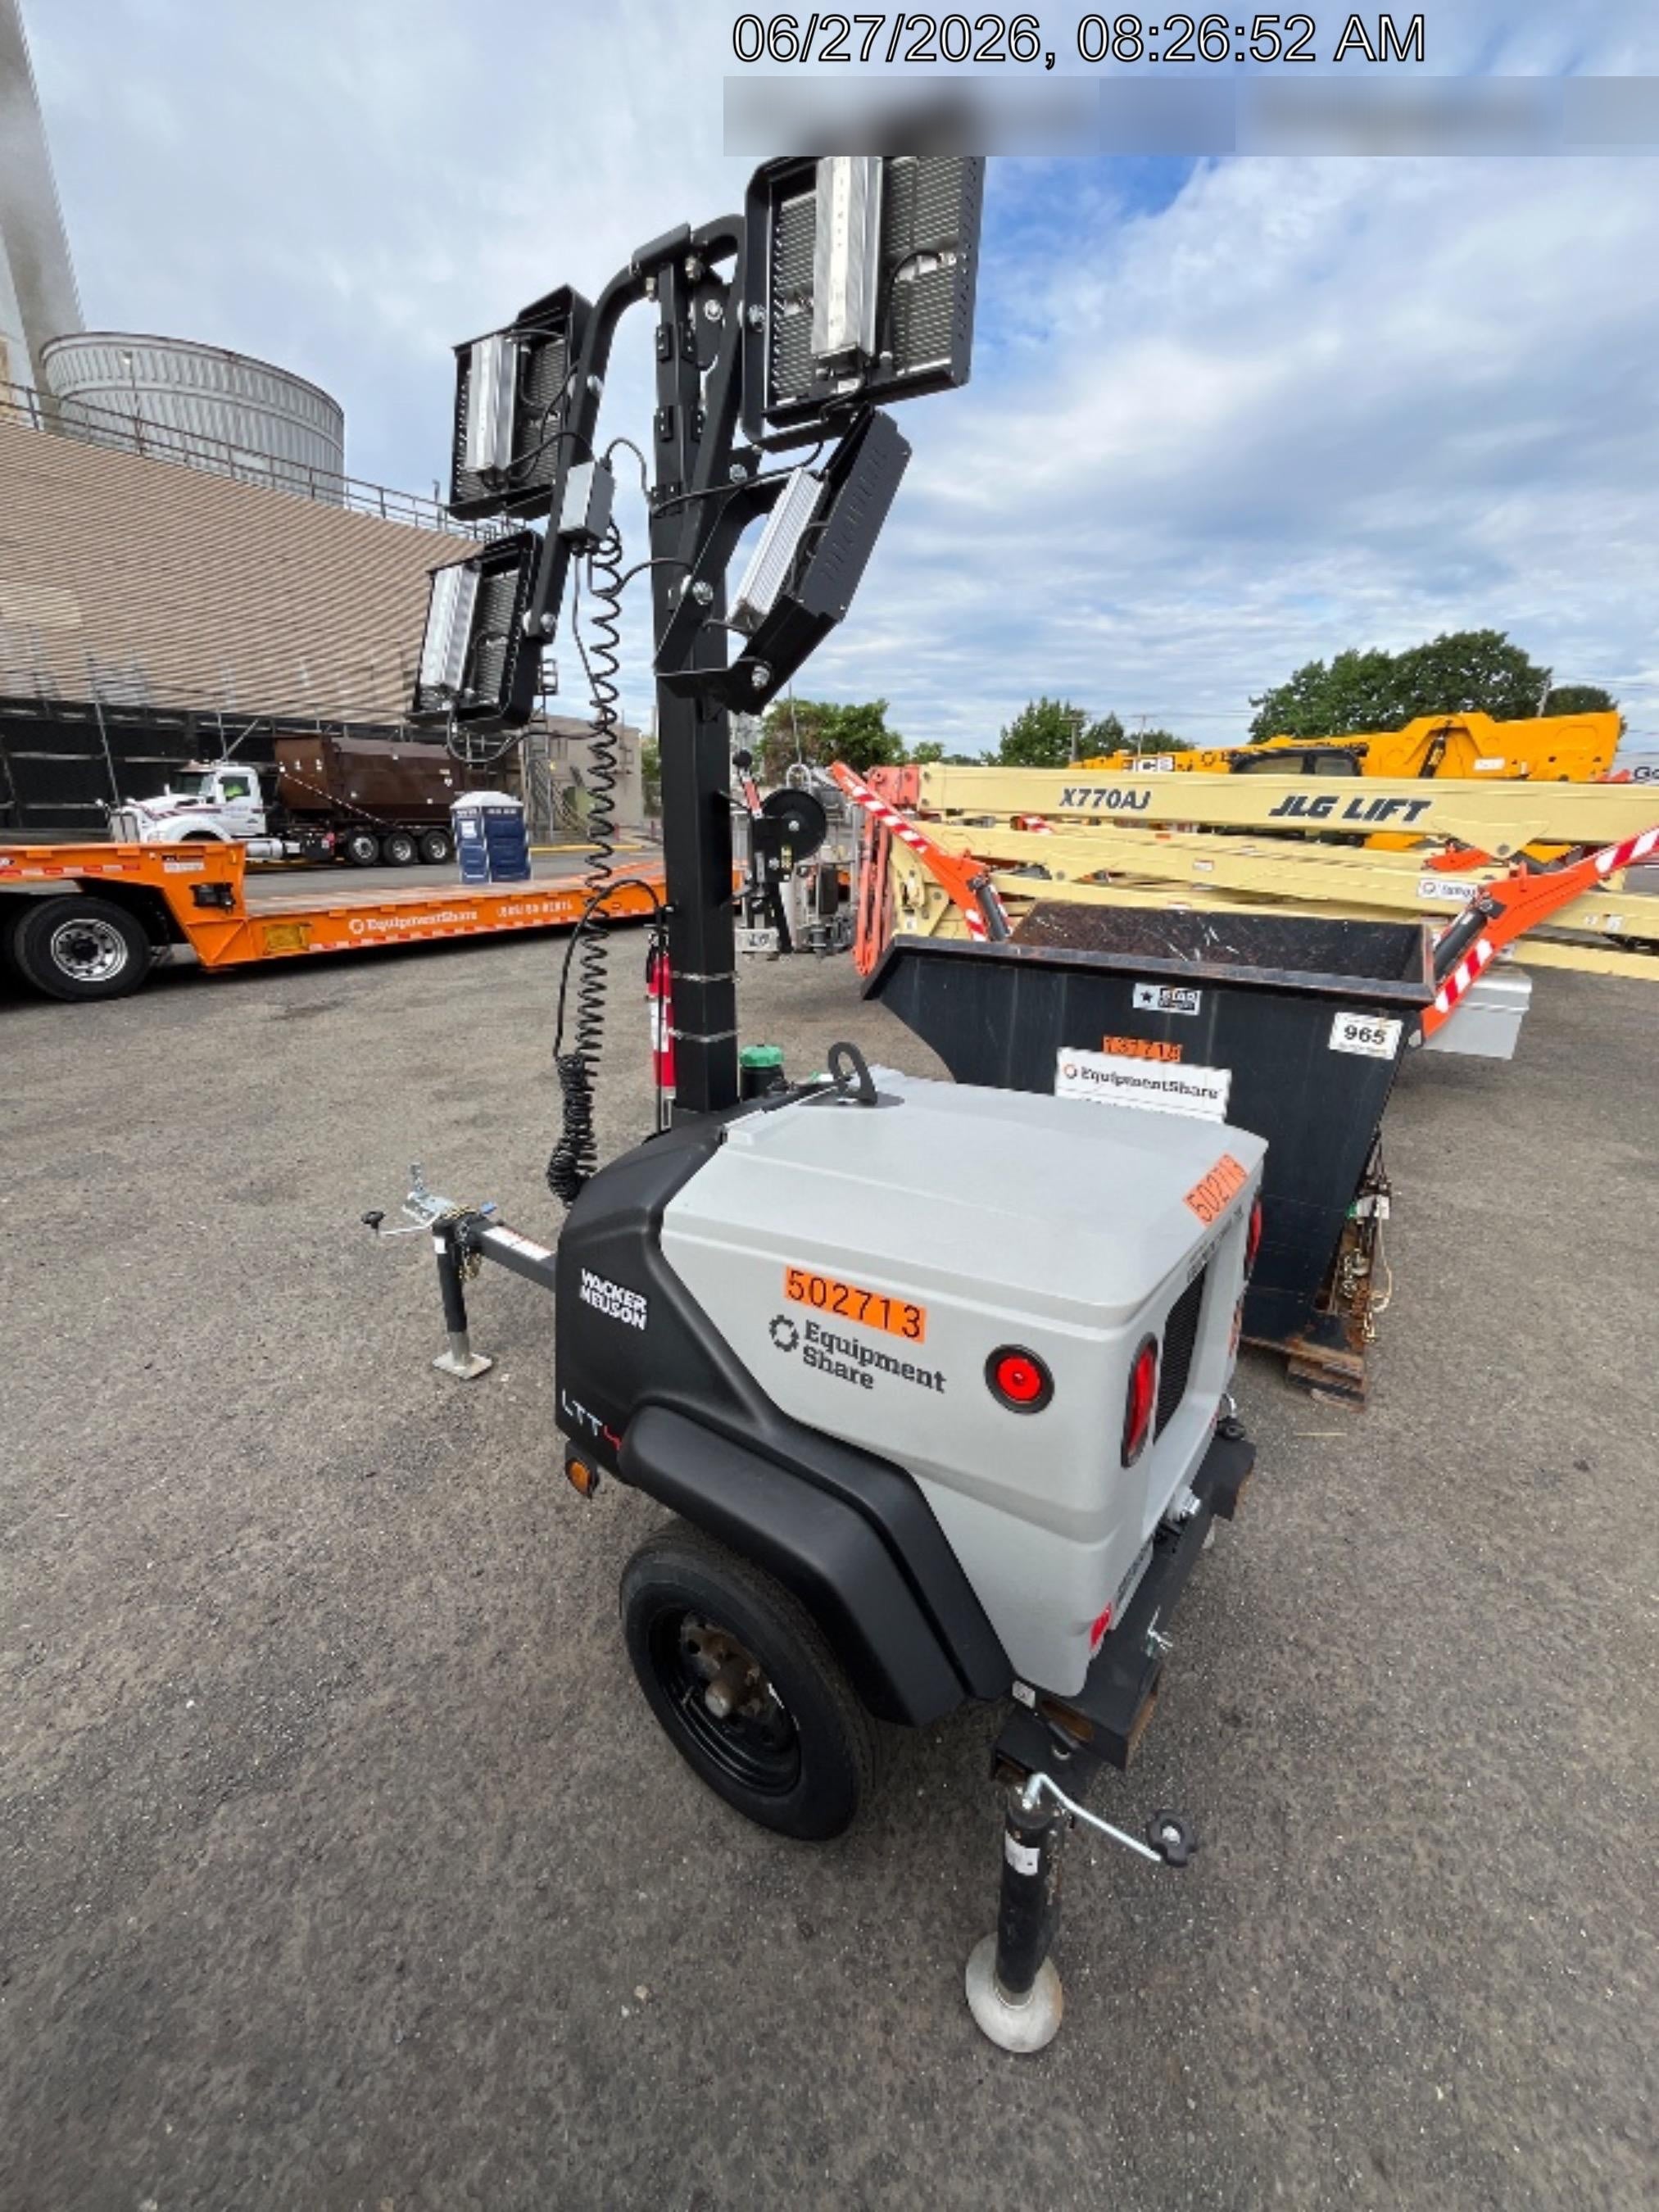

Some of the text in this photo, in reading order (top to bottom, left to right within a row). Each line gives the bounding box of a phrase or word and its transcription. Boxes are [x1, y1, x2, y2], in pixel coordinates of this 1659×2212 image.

[1059, 788, 1151, 810] X770AJ
[1268, 795, 1432, 823] JLG LIFT
[1344, 1024, 1387, 1045] 965
[1081, 1066, 1219, 1099] EquipmentShare
[579, 1285, 647, 1330] NEUSON
[581, 1267, 647, 1313] WACKER
[787, 1270, 921, 1338] 502713
[802, 1344, 874, 1389] Share
[804, 1319, 946, 1394] Equipment
